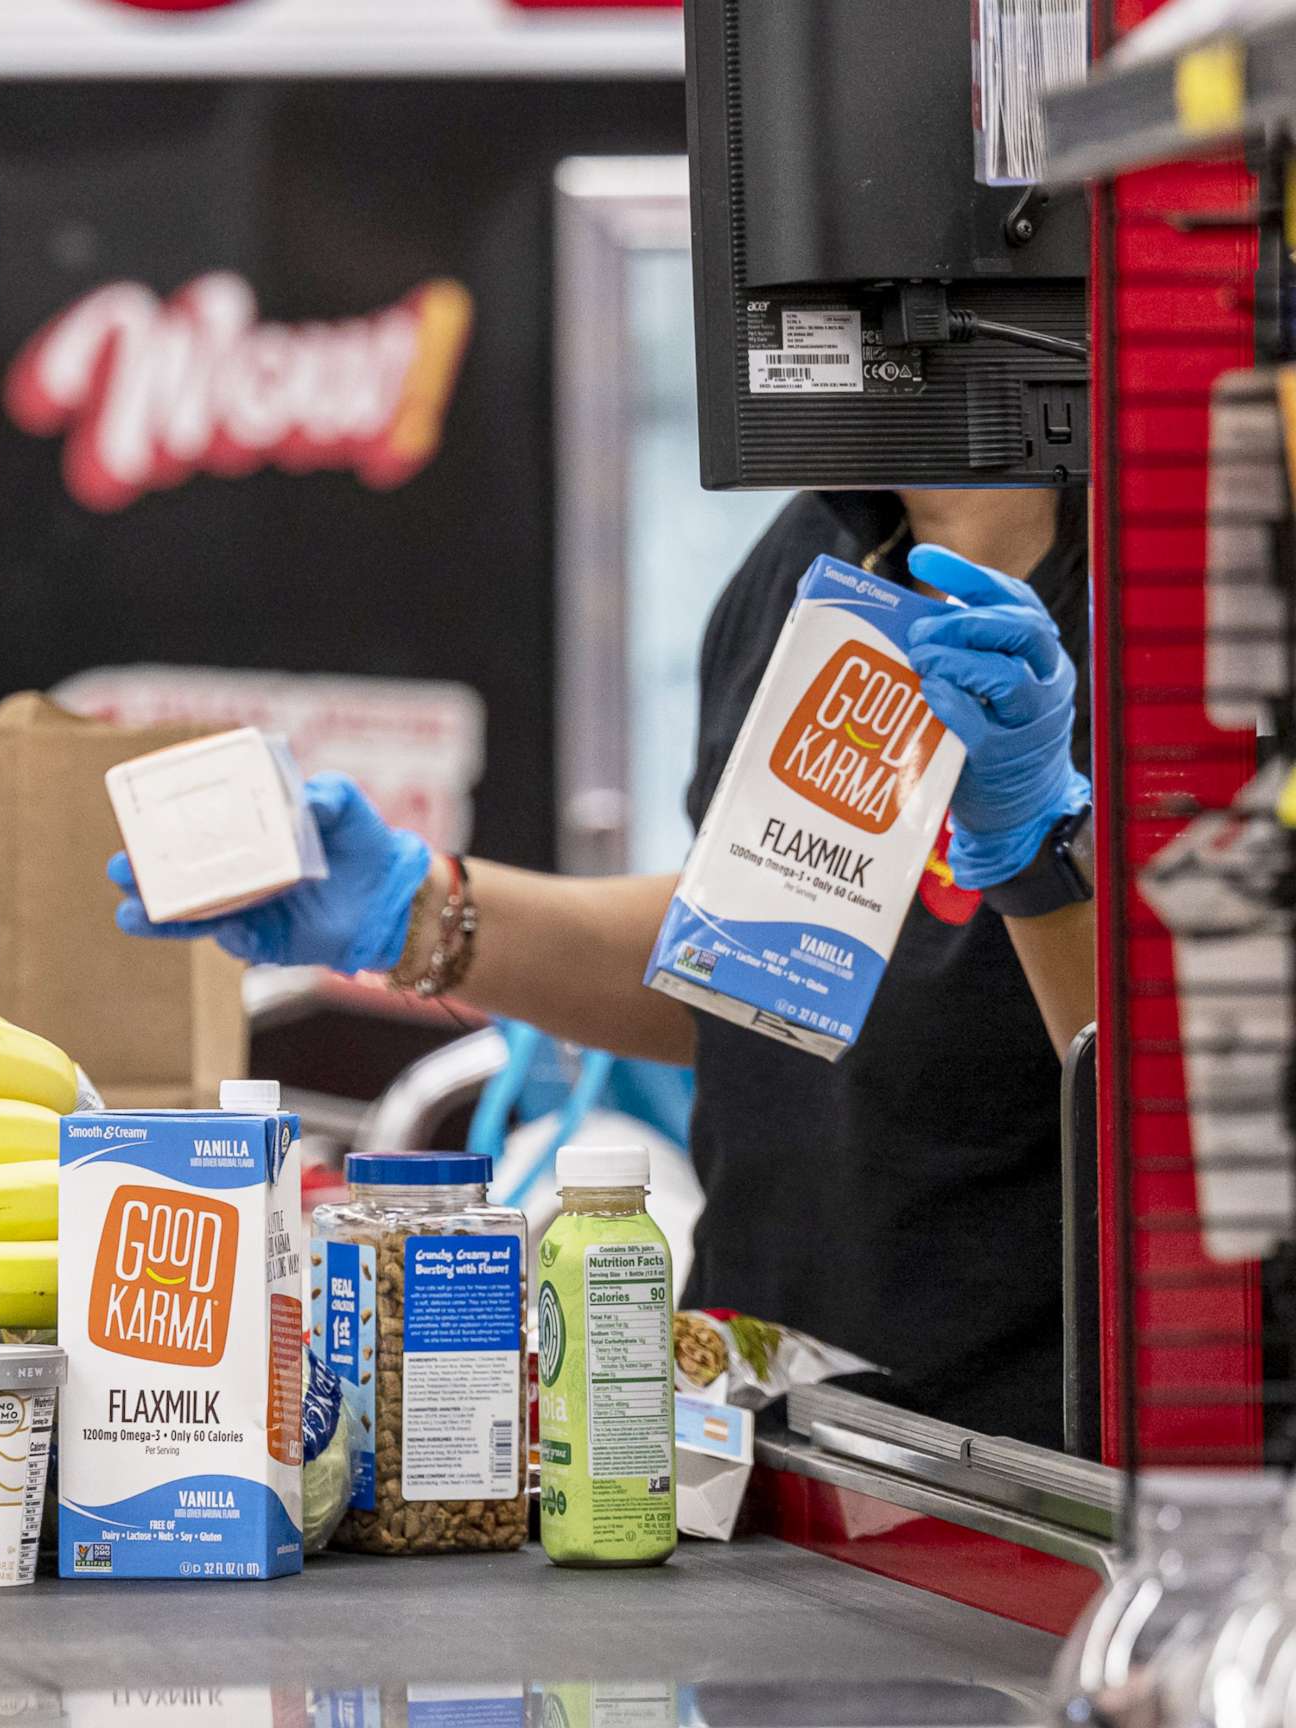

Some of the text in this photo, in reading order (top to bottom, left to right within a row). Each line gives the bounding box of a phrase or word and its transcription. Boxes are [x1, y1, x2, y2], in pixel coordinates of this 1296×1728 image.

[747, 301, 770, 311] acer
[816, 655, 934, 768] GOOD
[784, 723, 900, 823] KARMA
[760, 817, 874, 888] FLAXMILK
[729, 843, 763, 866] 1200mg
[812, 877, 832, 894] Only
[847, 890, 882, 913] Calories
[800, 933, 855, 969] VANILLA
[68, 1125, 147, 1140] Smooth & Creamy
[193, 1139, 249, 1157] VANILLA
[114, 1200, 222, 1293] GOOD
[456, 1249, 491, 1264] Creamy
[492, 1246, 510, 1259] and
[589, 1255, 664, 1268] Nutrition Facts
[415, 1264, 454, 1280] Bursting
[455, 1263, 477, 1275] with
[331, 1277, 355, 1299] REAL
[590, 1287, 665, 1302] Calories 90
[104, 1283, 213, 1353] KARMA
[333, 1314, 351, 1349] 1st
[17, 1367, 43, 1377] NEW
[108, 1389, 220, 1424] FLAXMILK
[82, 1429, 244, 1443] 1200mg Omega-3 Only 60 Calories
[145, 1446, 180, 1456] Per Serving
[178, 1491, 235, 1508] VANILLA
[150, 1520, 176, 1530] FREE OF
[102, 1530, 222, 1543] Dairy Lactose Nuts Soy Gluten
[204, 1563, 214, 1575] 32
[216, 1563, 224, 1575] FL
[225, 1563, 236, 1575] OZ
